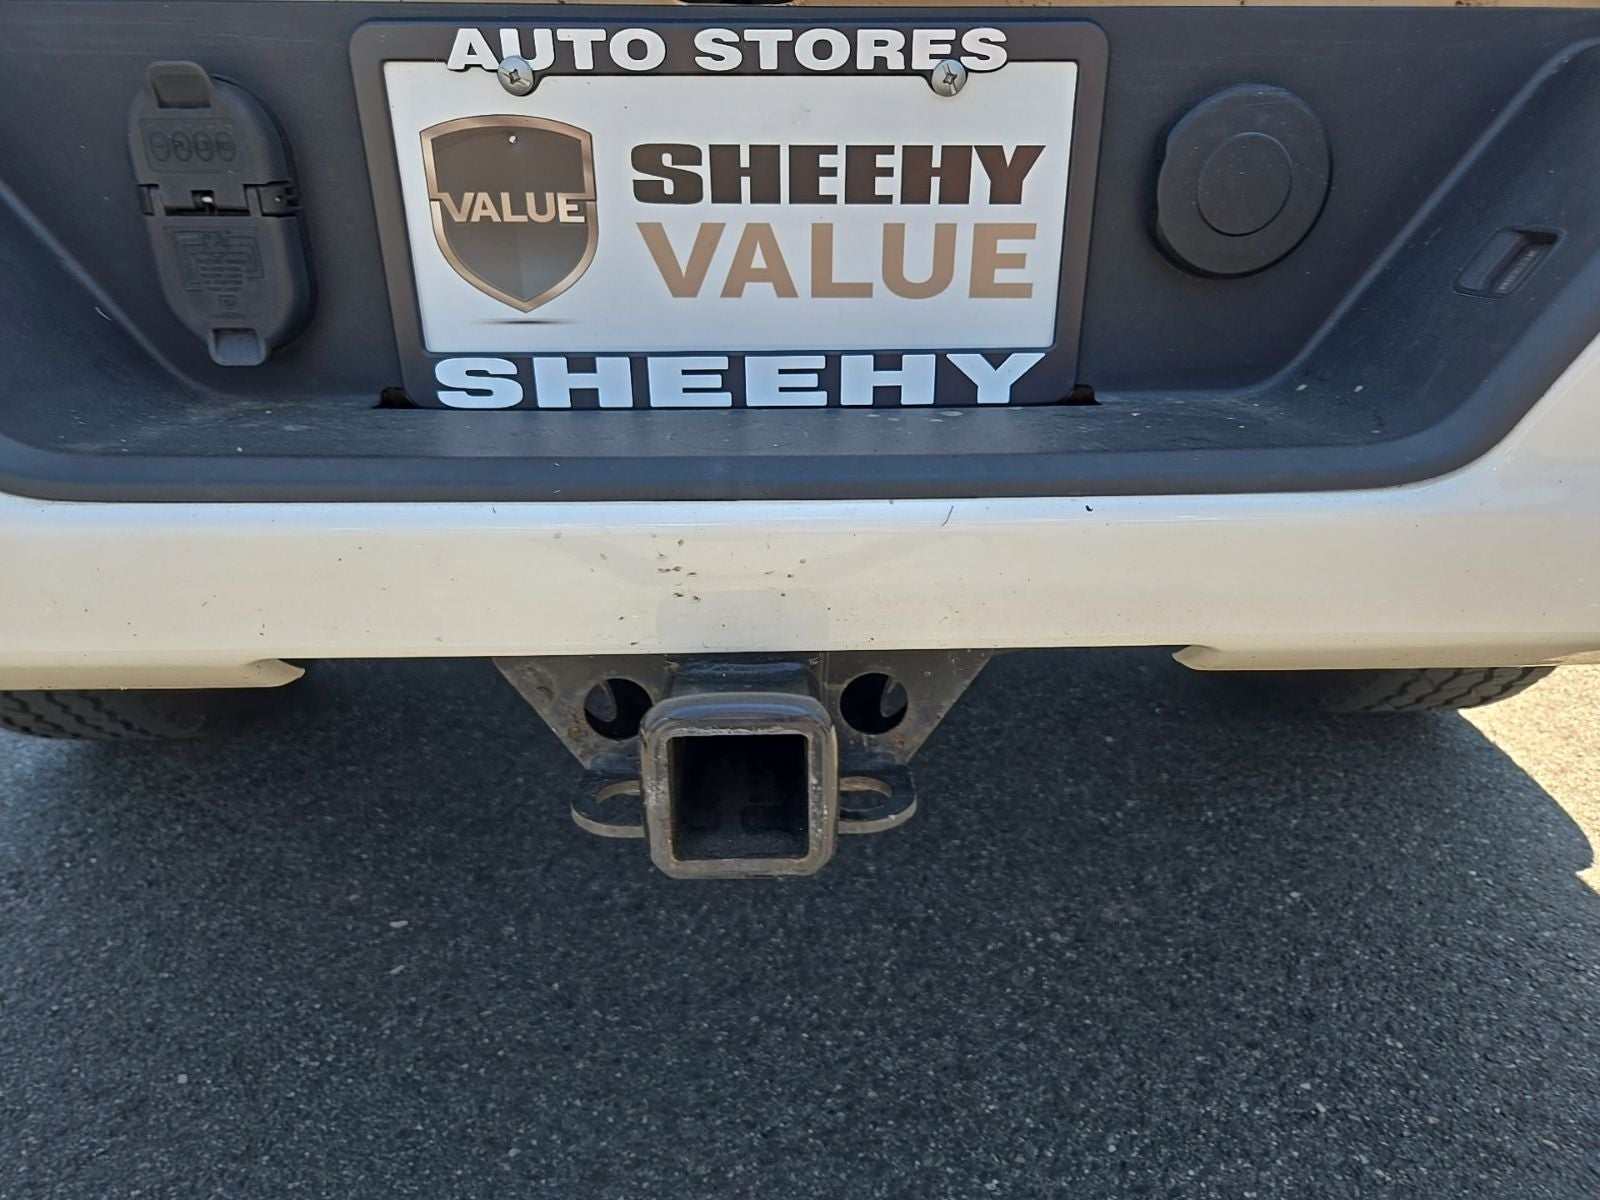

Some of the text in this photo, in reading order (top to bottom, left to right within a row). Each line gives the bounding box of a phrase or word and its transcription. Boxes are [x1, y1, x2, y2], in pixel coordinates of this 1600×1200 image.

[446, 27, 1009, 73] AUTO STORES
[632, 143, 1046, 205] SHEEHY
[441, 191, 586, 224] VALUE
[636, 222, 1037, 299] VALUE
[434, 352, 1046, 410] SHEEHY
